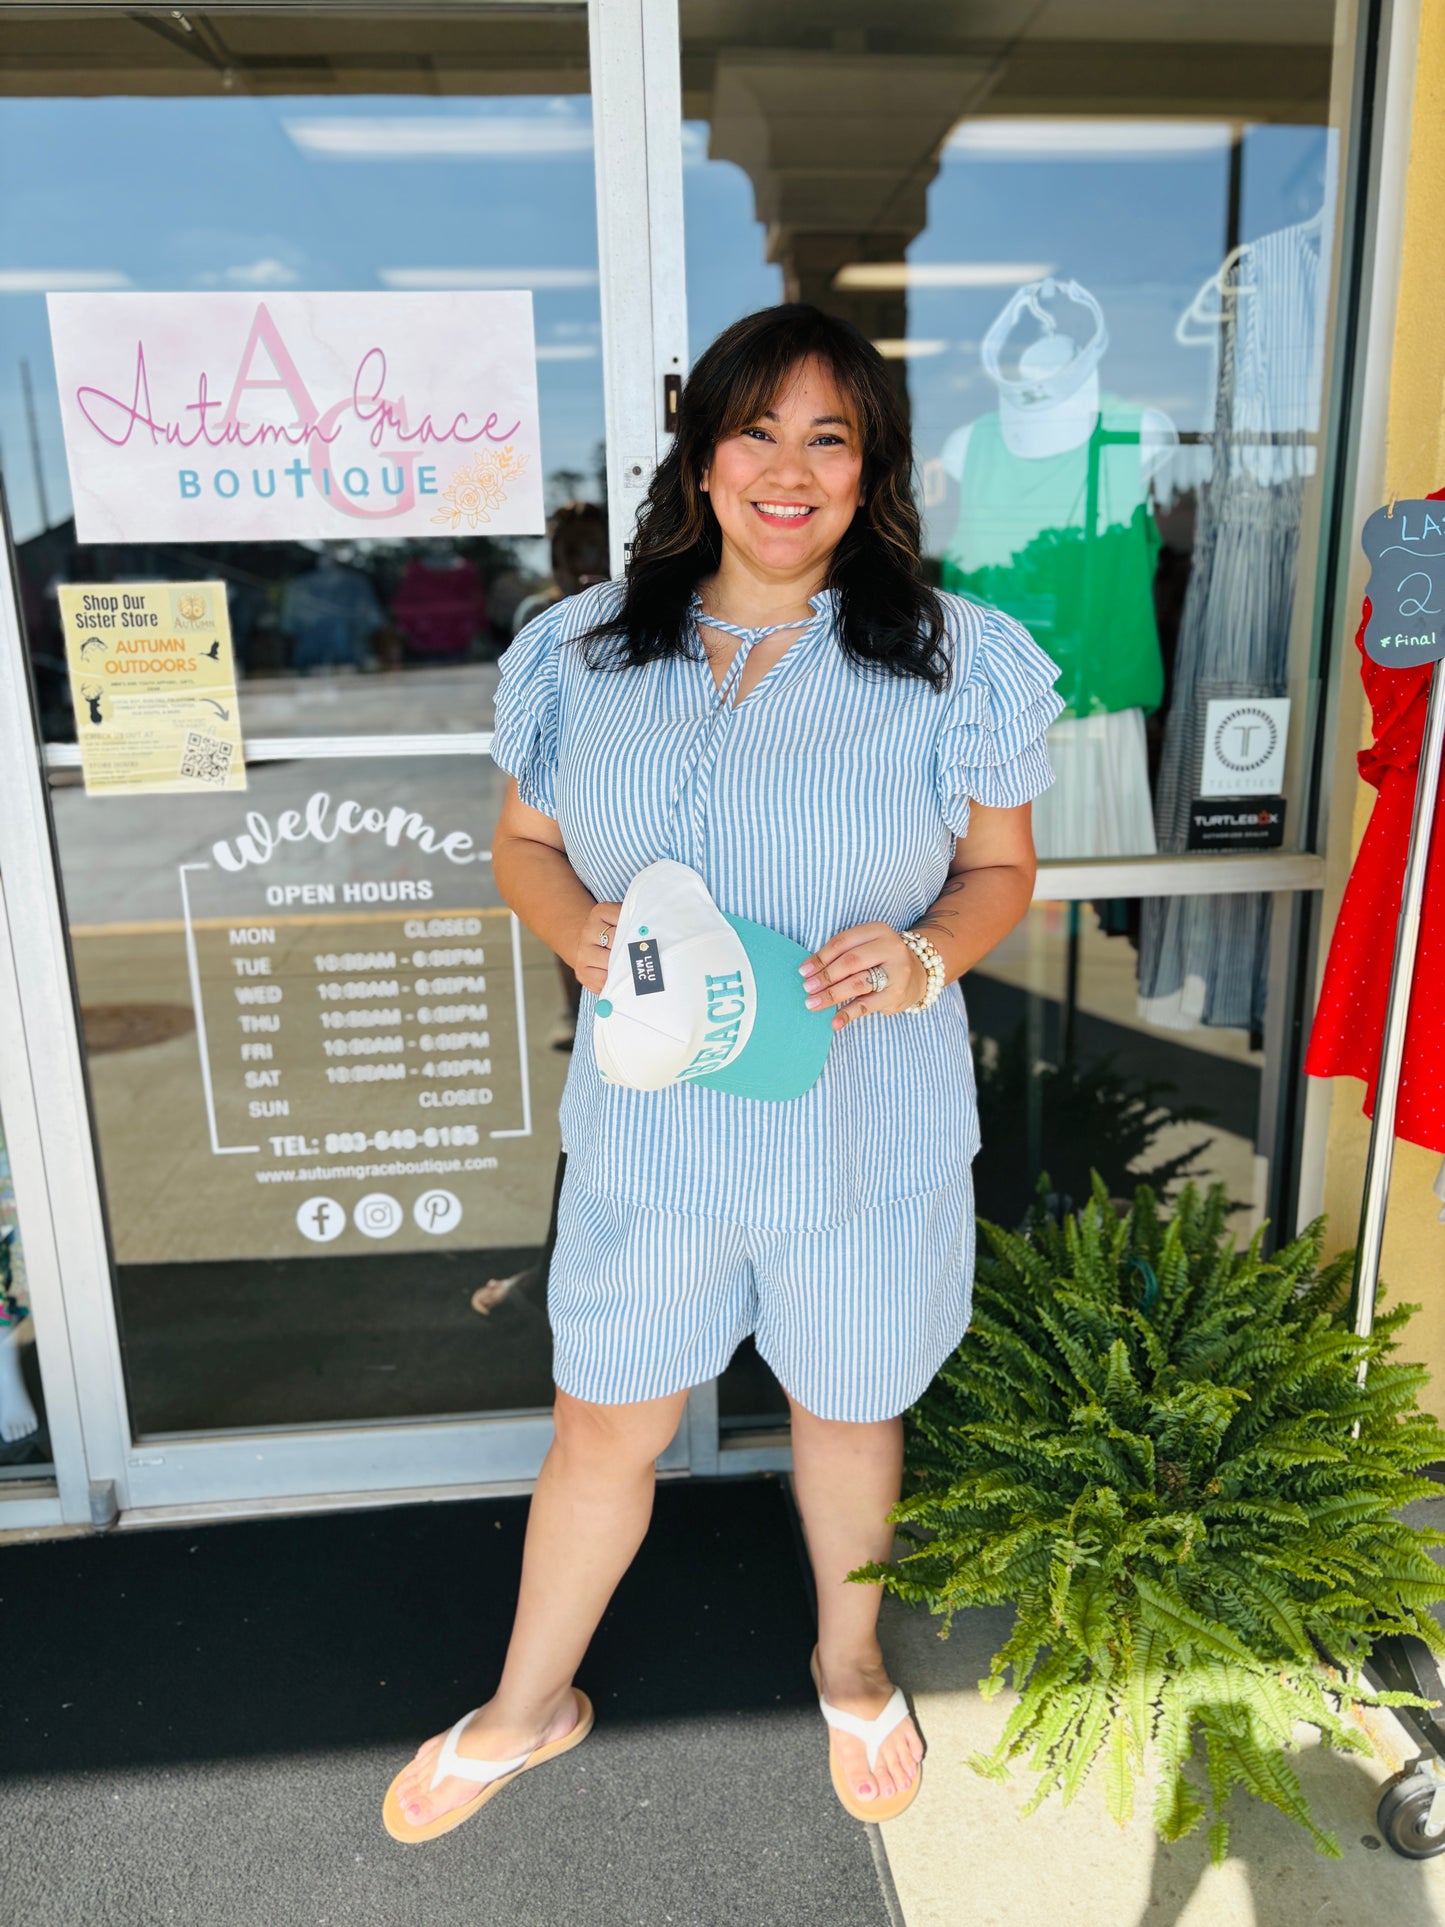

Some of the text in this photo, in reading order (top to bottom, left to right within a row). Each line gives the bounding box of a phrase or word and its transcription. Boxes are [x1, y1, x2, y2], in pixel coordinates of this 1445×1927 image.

[76, 340, 521, 447] Autumn Grace
[178, 458, 439, 499] BOUTIQUE
[1401, 513, 1445, 541] LA
[83, 594, 146, 613] Shop Our
[75, 612, 159, 629] Sister Store
[115, 638, 186, 655] AUTUMN
[104, 657, 197, 675] OUTDOORS
[212, 791, 477, 872] welcome
[266, 880, 434, 906] OPEN HOURS
[228, 917, 482, 945] MON CLOSED
[233, 957, 272, 976] TUE
[635, 958, 646, 981] MAC
[644, 955, 656, 982] LULU
[234, 985, 283, 1005] WED
[238, 1014, 280, 1032] THU
[240, 1043, 273, 1061] FRI
[244, 1070, 281, 1089] SAT
[248, 1088, 493, 1118] SUN CLOSED
[268, 1135, 320, 1157] TEL:
[255, 1156, 498, 1184] www.autumngraceboutique.com
